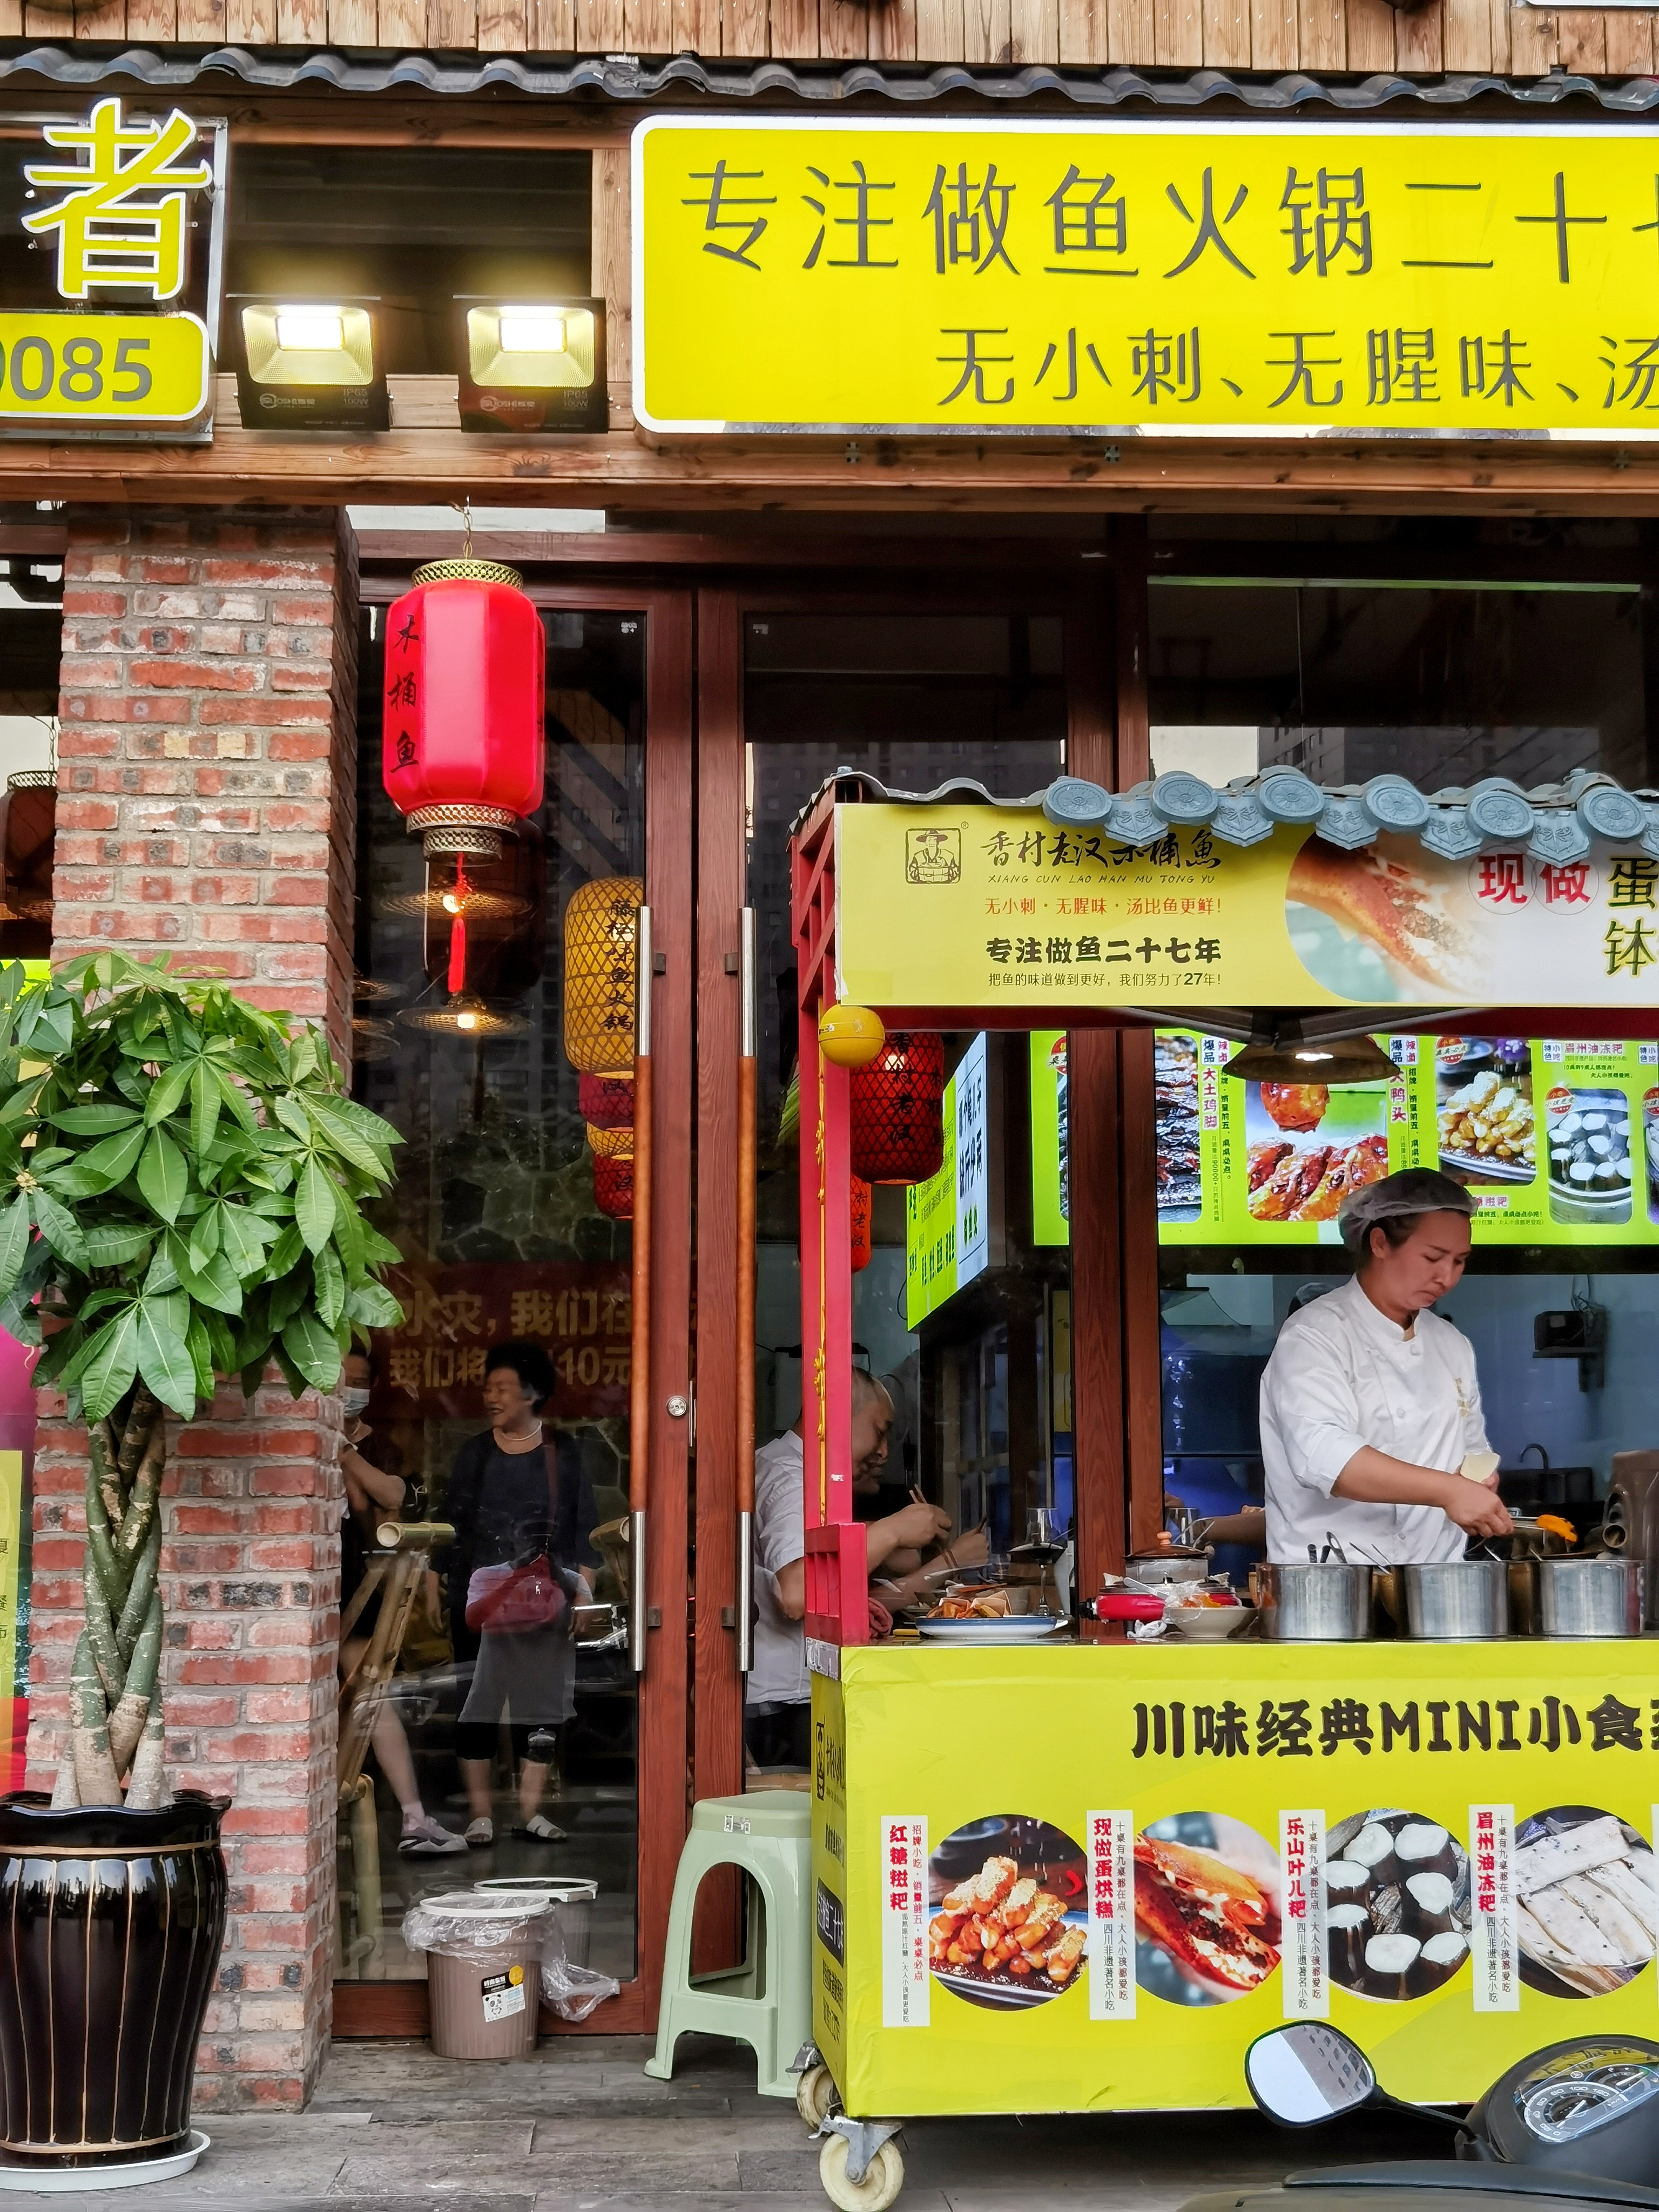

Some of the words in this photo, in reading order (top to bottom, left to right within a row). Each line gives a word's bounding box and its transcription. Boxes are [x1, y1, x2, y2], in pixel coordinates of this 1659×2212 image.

[21, 97, 212, 300] 者
[680, 159, 1659, 284] 专注做鱼火锅二十
[988, 874, 1029, 884] XIANG
[1036, 874, 1062, 884] CUN
[1069, 875, 1092, 884] LAO
[1098, 875, 1128, 884] HAN
[1134, 875, 1154, 884] MU
[1159, 875, 1195, 884] TONG
[1200, 875, 1215, 884] YU
[1478, 853, 1591, 905] 现做
[986, 935, 1222, 965] 专注做鱼二十七年
[851, 1182, 869, 1249] 村老汉
[1131, 1694, 1659, 1759] 川味经典MINI小食
[889, 1824, 909, 1912] 红糖糍粑
[1094, 1817, 1114, 1920] 现做蛋烘糕
[1286, 1817, 1307, 1919] 乐山叶儿粑
[1475, 1811, 1496, 1912] 眉州油冻粑
